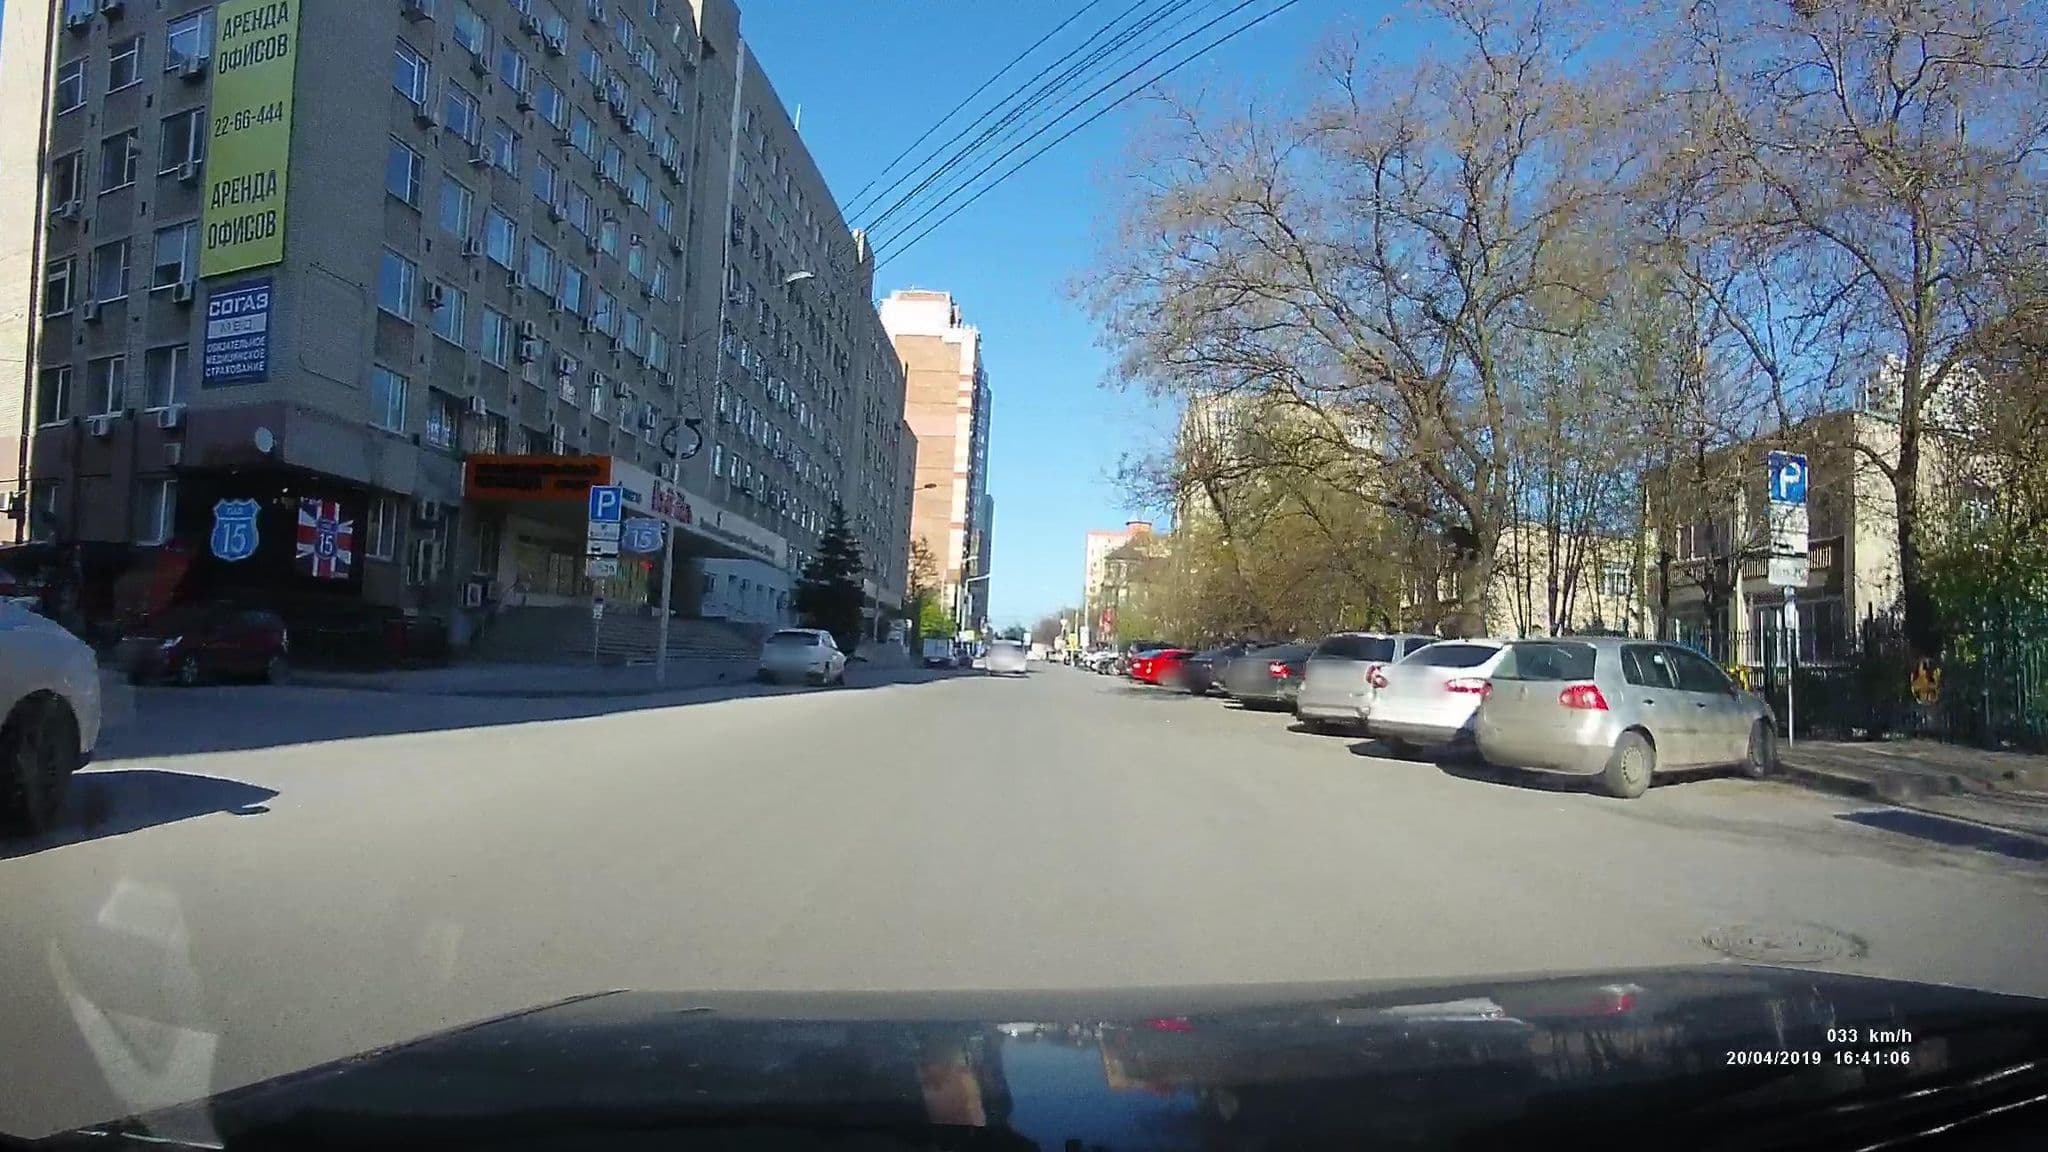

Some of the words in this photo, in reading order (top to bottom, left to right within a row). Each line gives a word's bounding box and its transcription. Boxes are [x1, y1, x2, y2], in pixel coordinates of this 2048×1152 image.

[222, 1, 288, 41] АРЕНДА
[219, 33, 288, 74] ОФИСОВ
[214, 101, 283, 137] 22-66-444
[210, 169, 277, 210] АРЕНДА
[208, 210, 276, 250] ОФИСОВ
[209, 293, 269, 316] СОГАЗ
[204, 361, 265, 377] СТРАХОВАНИЕ
[223, 523, 247, 553] 15
[319, 533, 334, 555] 15
